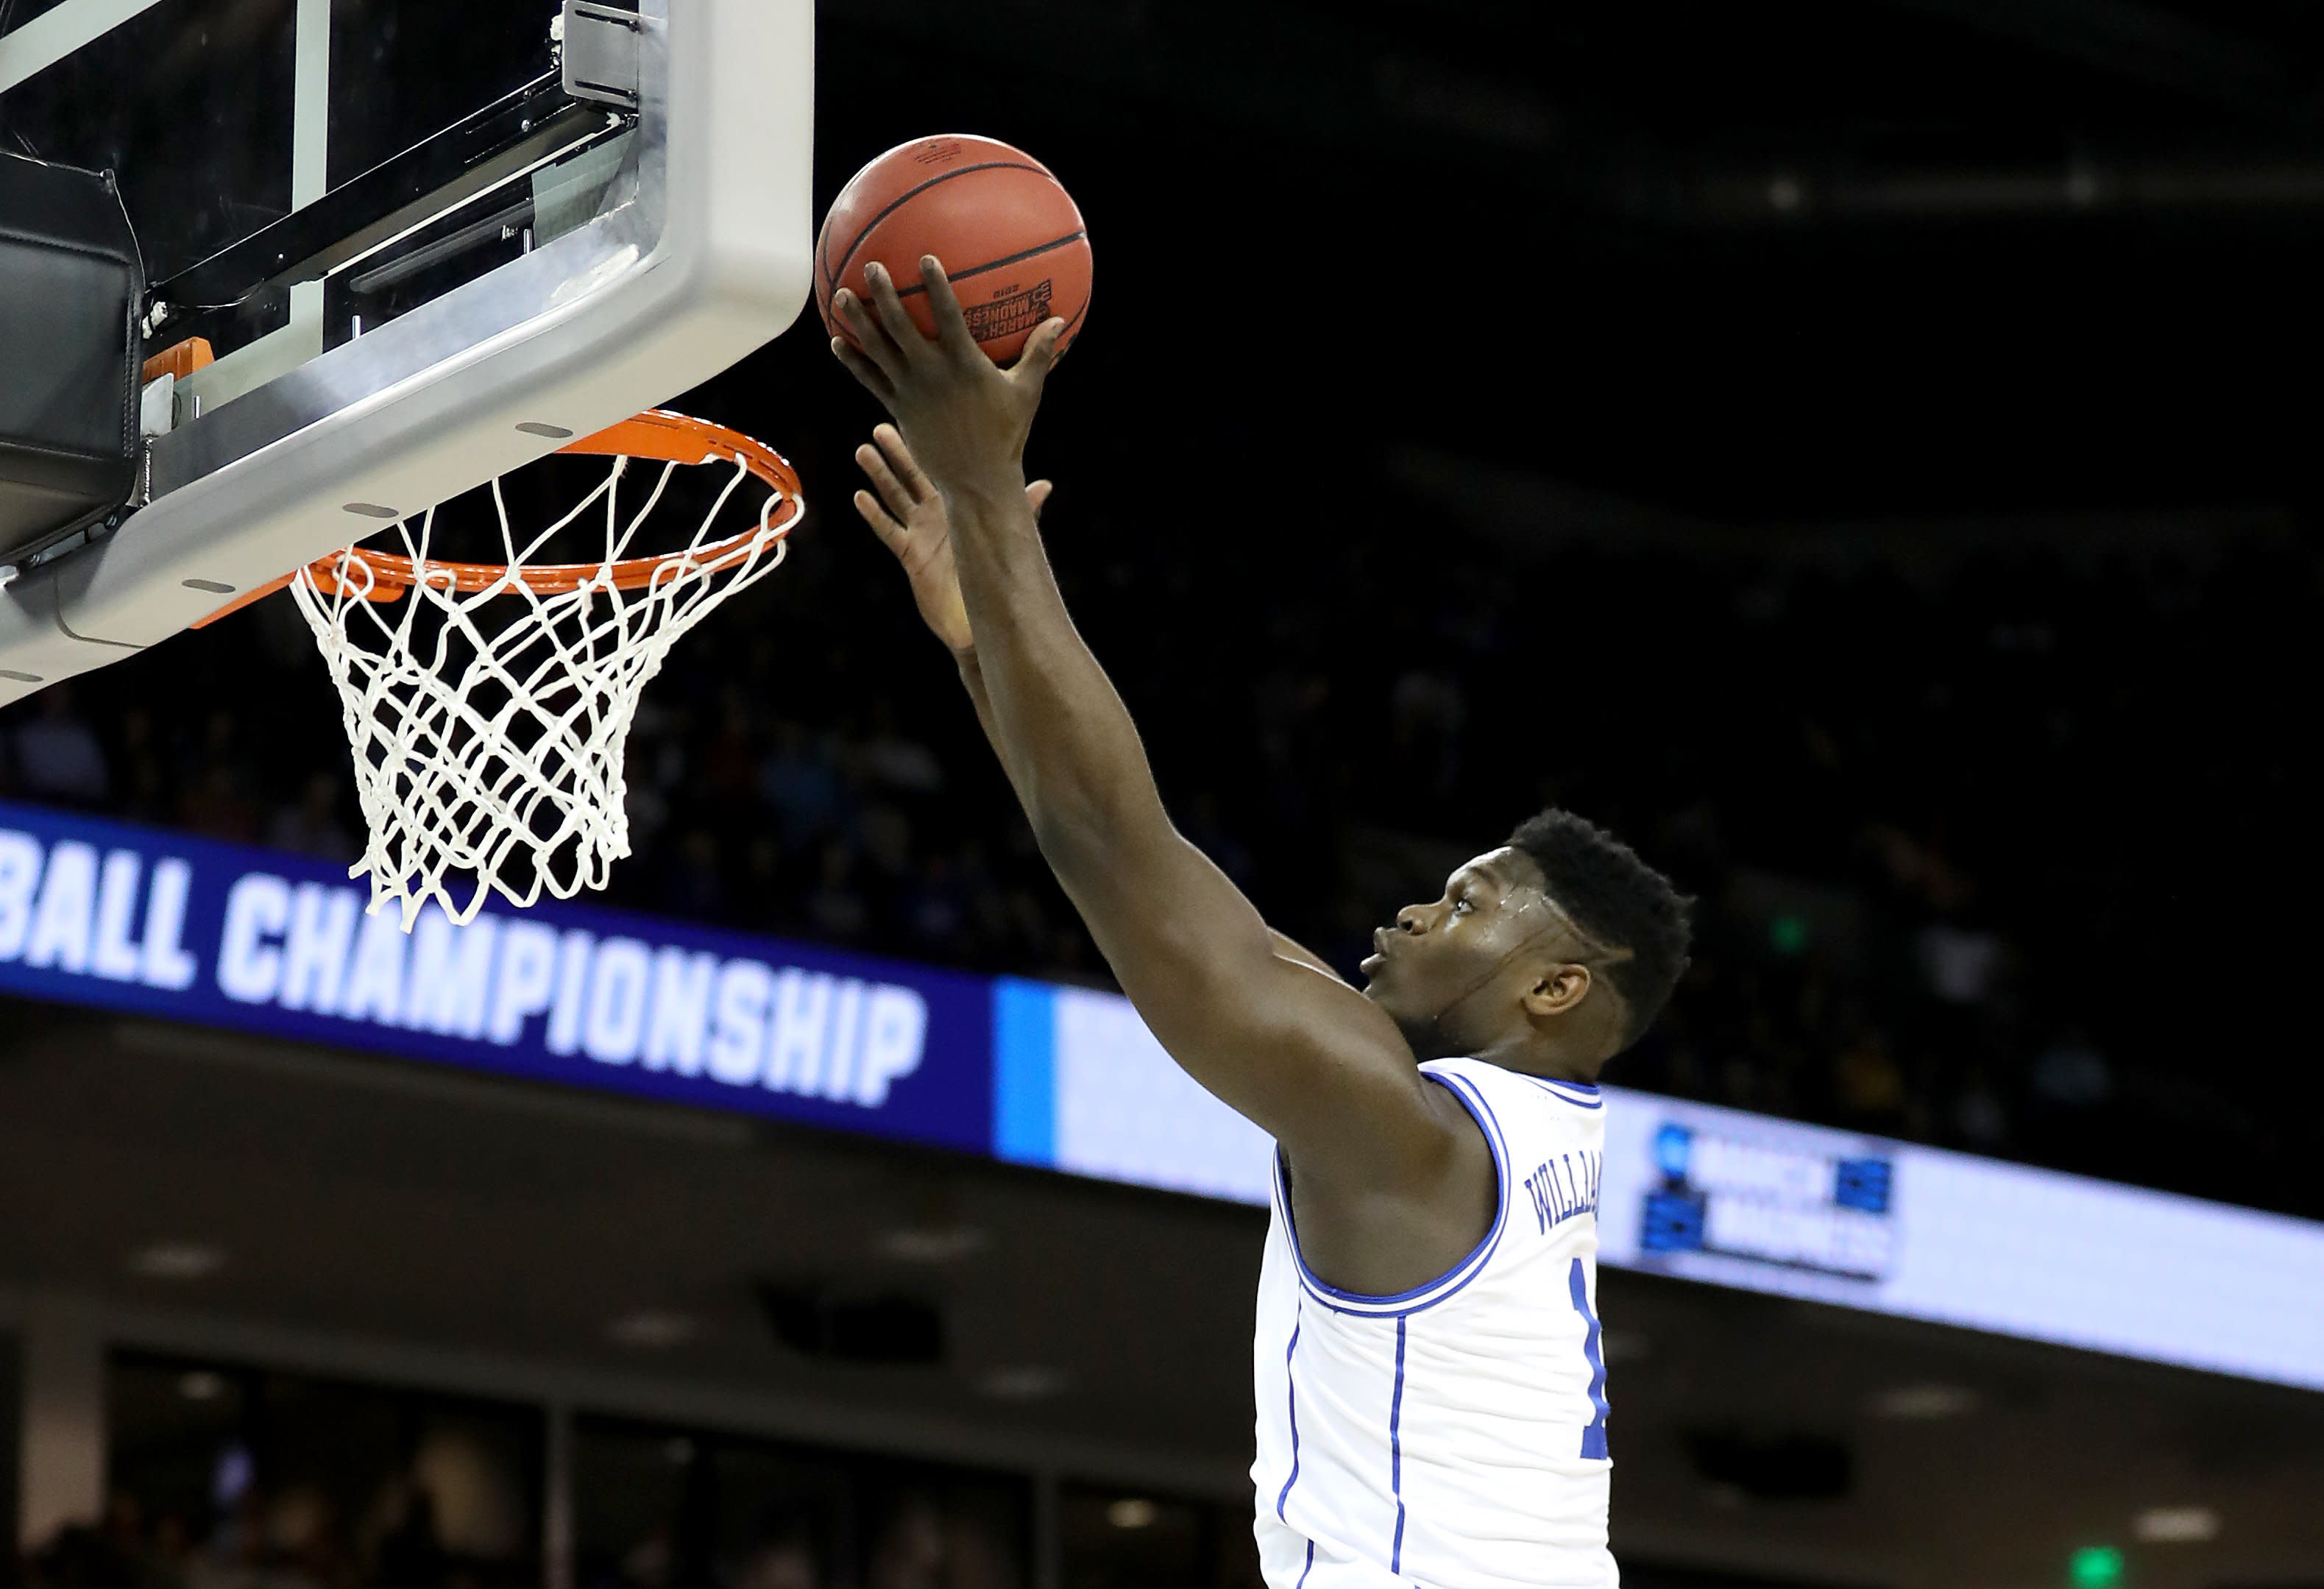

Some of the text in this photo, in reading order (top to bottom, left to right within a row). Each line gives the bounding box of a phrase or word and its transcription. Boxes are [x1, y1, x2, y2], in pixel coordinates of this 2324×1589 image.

[964, 296, 1030, 329] MADNESS
[989, 311, 1036, 338] MARCH
[0, 827, 927, 1108] BALL CHAMPIONSHIP
[1524, 1150, 1601, 1236] WILLIA
[1568, 1257, 1611, 1460] 1
